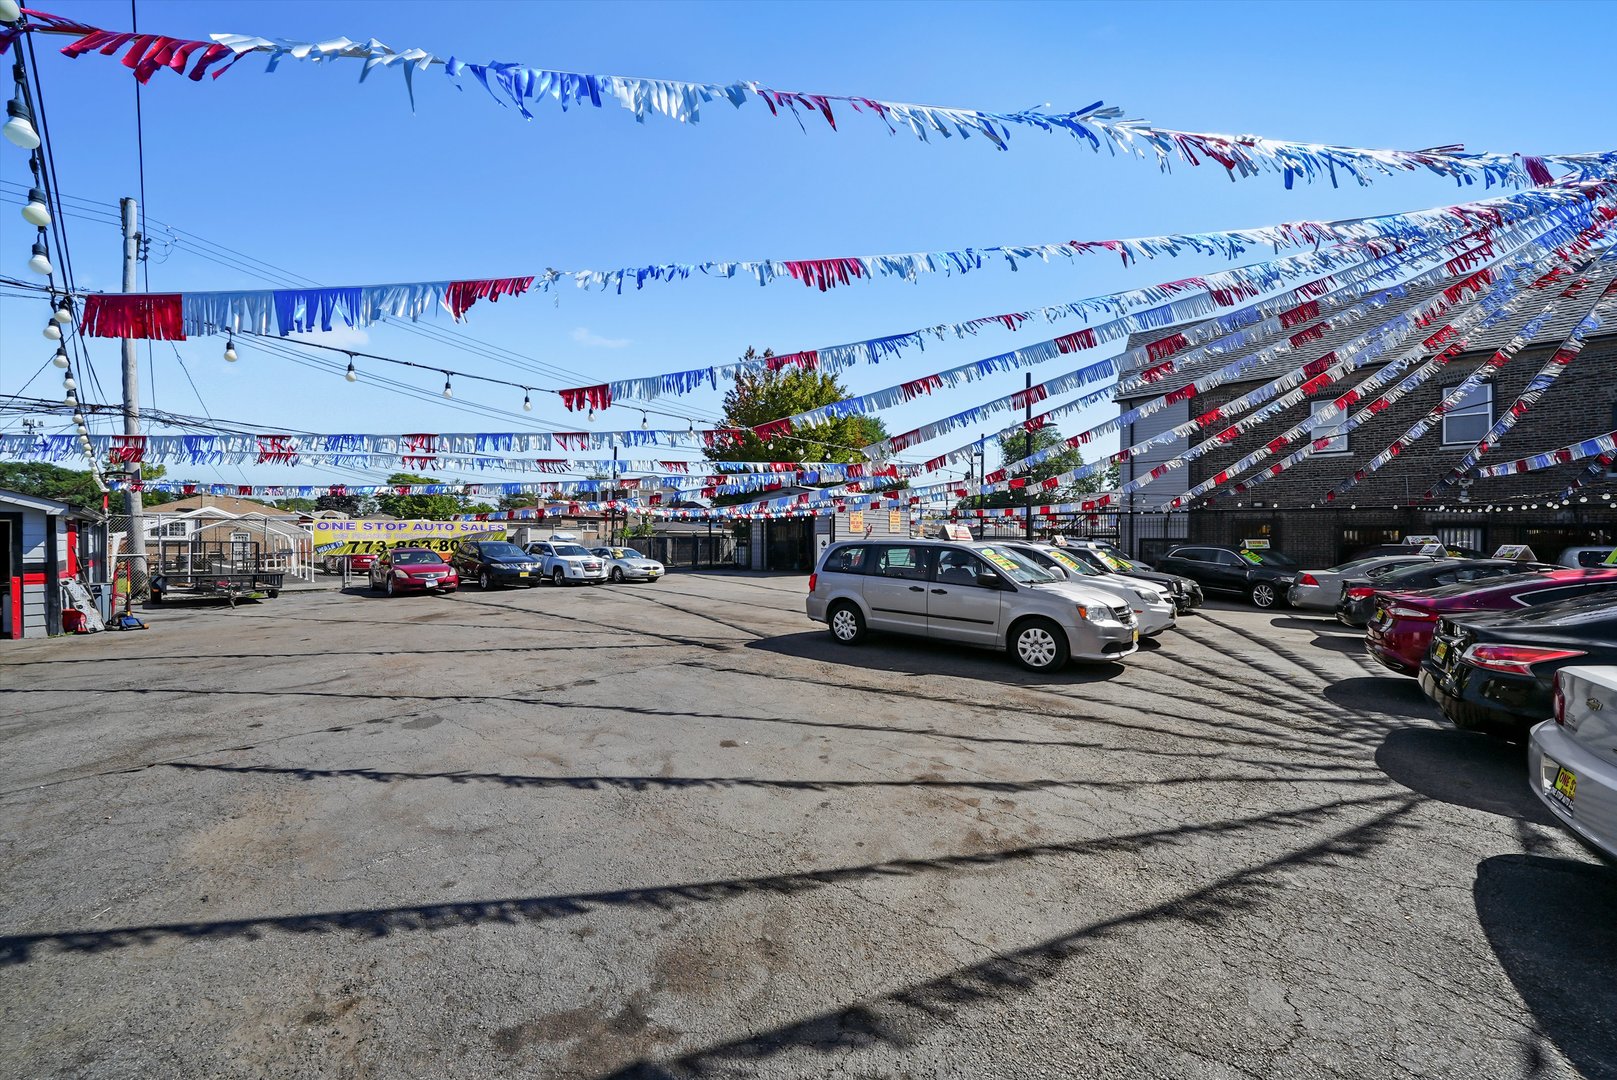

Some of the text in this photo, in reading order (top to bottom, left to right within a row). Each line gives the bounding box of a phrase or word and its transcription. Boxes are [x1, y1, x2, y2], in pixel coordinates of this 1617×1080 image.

[316, 521, 505, 532] ONE STOP AUTO SALES
[348, 540, 460, 554] 773-863-80
